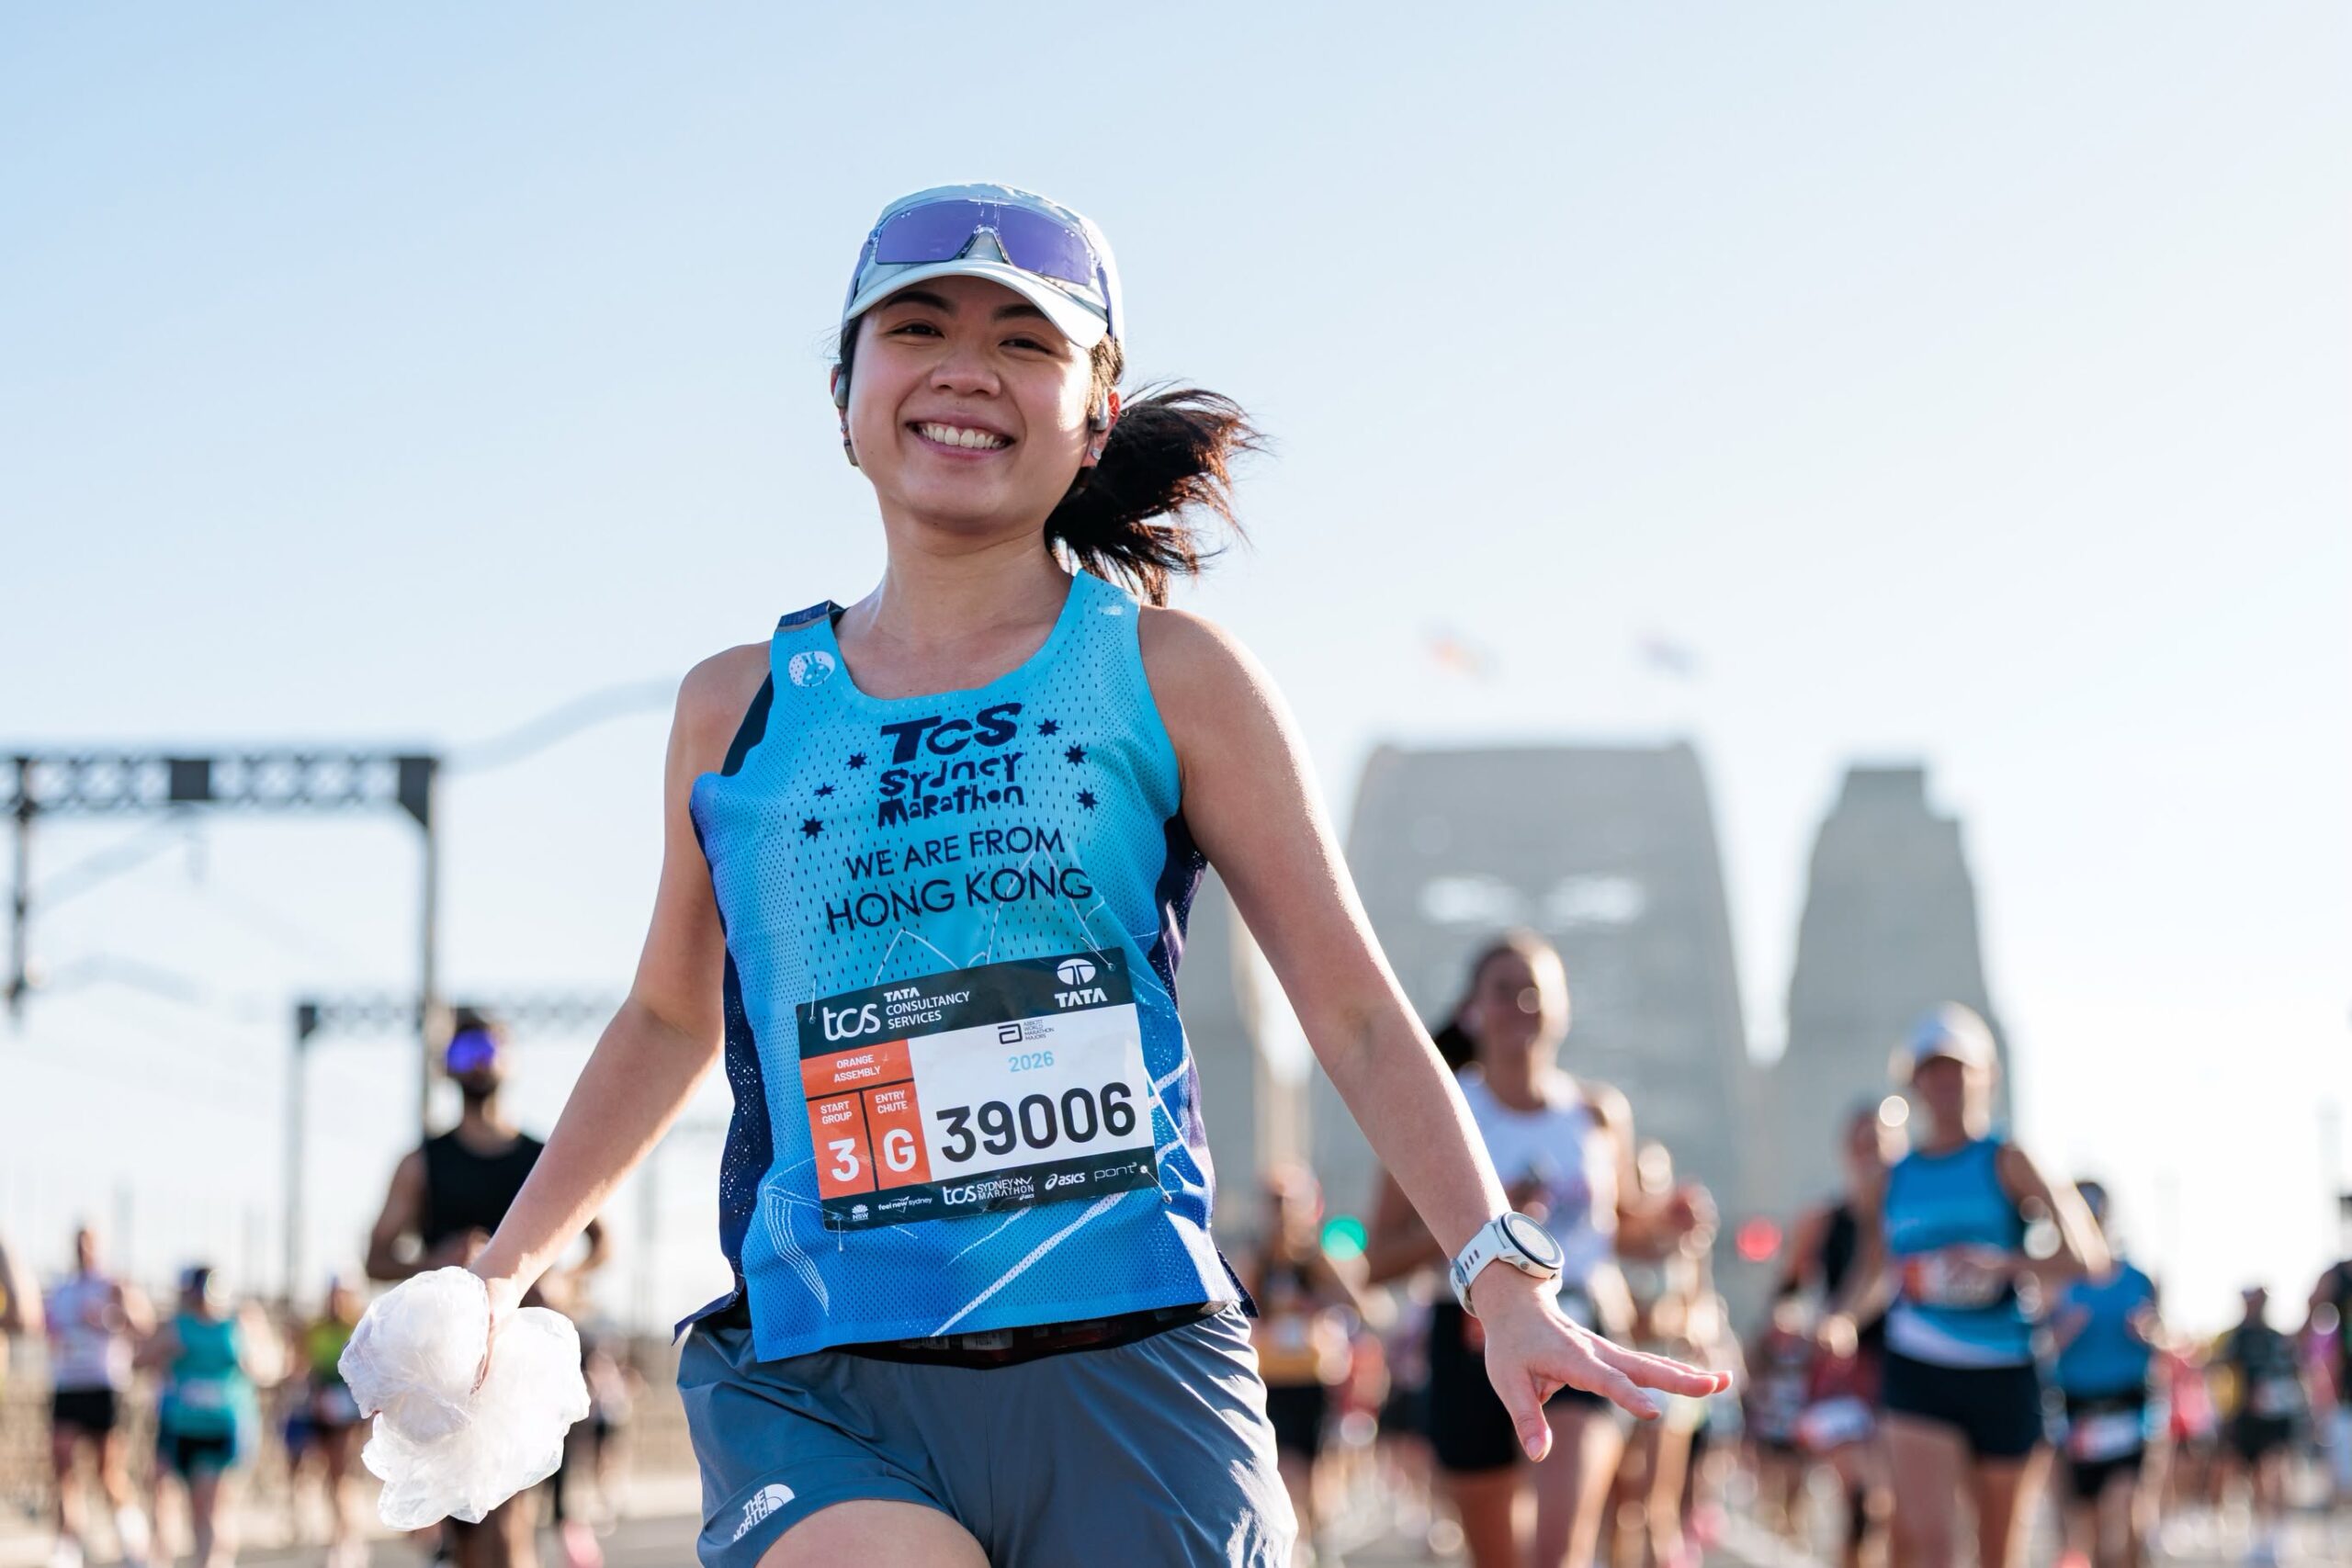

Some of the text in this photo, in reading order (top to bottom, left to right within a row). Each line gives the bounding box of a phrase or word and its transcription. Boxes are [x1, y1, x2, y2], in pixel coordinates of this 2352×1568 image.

[880, 703, 1023, 764] TCS
[879, 751, 1023, 798] Sydney
[845, 827, 1065, 880] WE ARE FROM
[826, 867, 1092, 935] HONG KONG
[883, 987, 920, 1001] TATA
[886, 990, 970, 1016] CONSULTANCY
[1054, 987, 1108, 1008] TATA
[888, 1010, 942, 1030] SERVICES
[1024, 1027, 1055, 1036] MARATHON
[836, 1055, 875, 1069] ORANGE
[1008, 1051, 1055, 1073] 2026
[833, 1066, 881, 1083] ASSEMBLY
[820, 1100, 851, 1115] START
[875, 1089, 906, 1105] ENTRY
[876, 1100, 908, 1115] CHUTE
[821, 1111, 853, 1125] GROUP
[935, 1081, 1136, 1164] 39006
[828, 1138, 860, 1182] 3
[882, 1129, 917, 1173] G
[978, 1179, 1014, 1192] SYDNEY
[978, 1184, 1035, 1201] MARATHON
[742, 1489, 765, 1517] THE
[732, 1501, 769, 1542] NORTH
